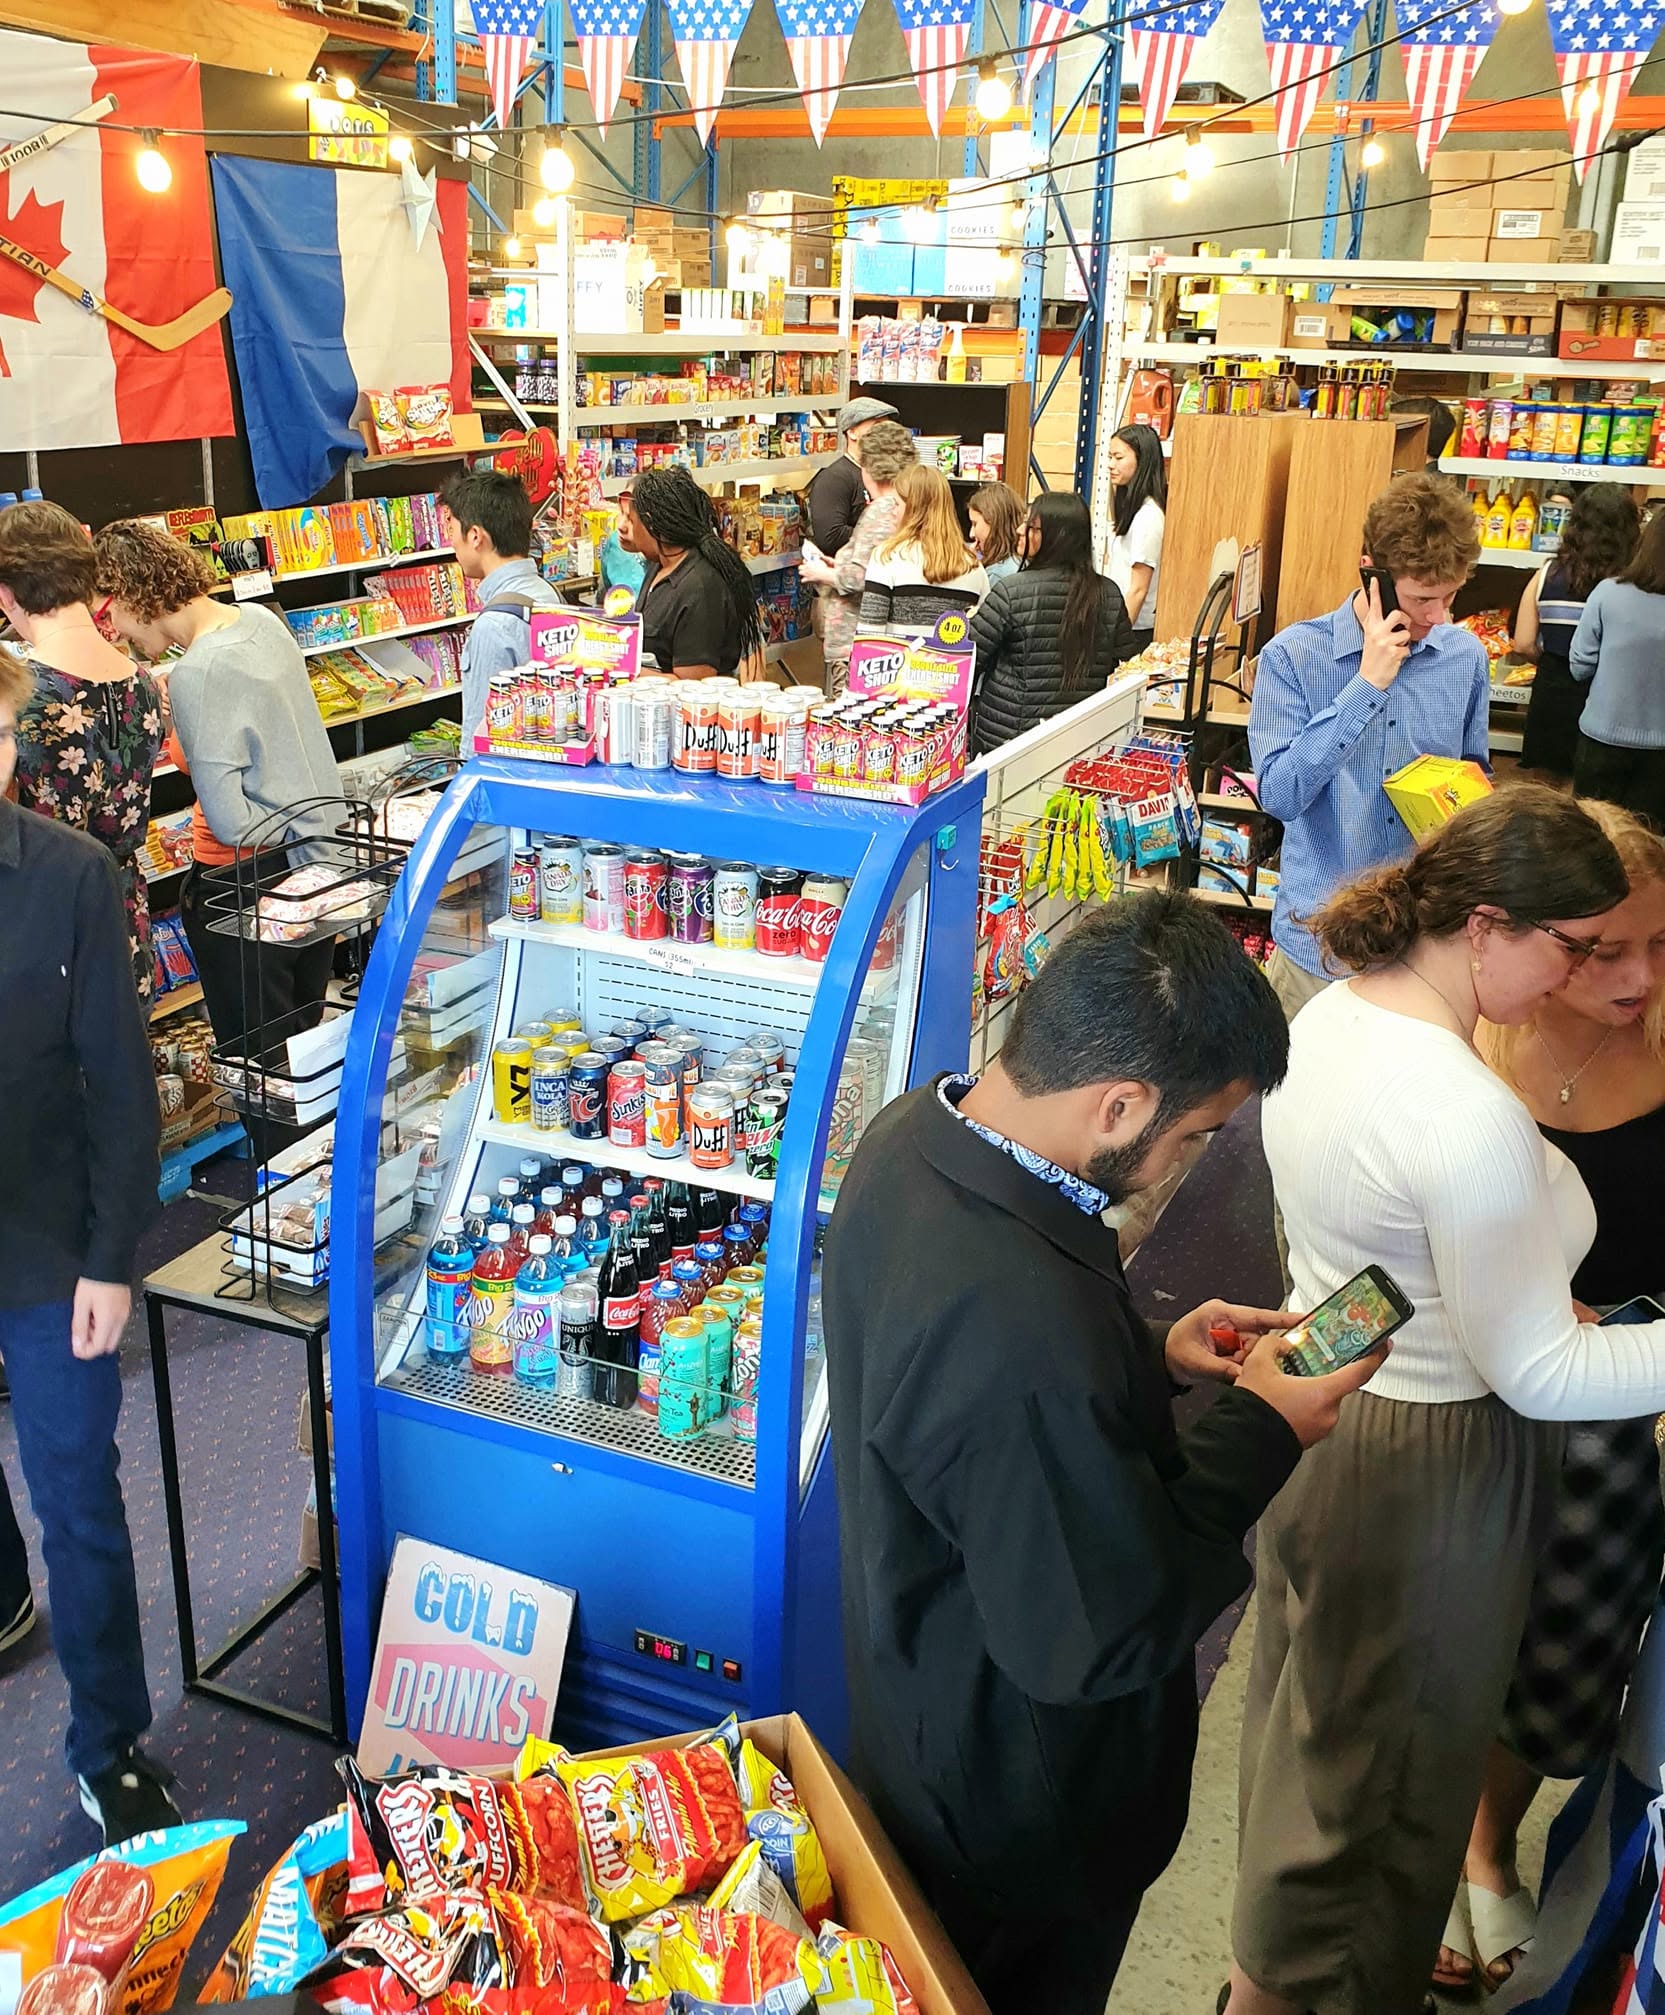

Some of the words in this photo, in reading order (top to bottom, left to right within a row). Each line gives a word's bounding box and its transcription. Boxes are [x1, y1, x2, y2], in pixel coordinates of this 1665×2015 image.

[577, 281, 603, 293] FFY
[1561, 465, 1600, 478] Snacks
[944, 622, 950, 632] 4
[537, 624, 579, 648] KETO
[544, 643, 575, 658] SHOT
[857, 652, 905, 678] KETO
[864, 671, 899, 688] SHOT
[1491, 688, 1527, 700] heetos
[489, 704, 515, 721] KETO
[685, 721, 718, 751] Duff
[719, 728, 750, 757] Duff
[762, 732, 777, 761] uff
[816, 741, 834, 754] KE
[833, 741, 859, 757] KETO
[867, 743, 894, 759] KETO
[900, 748, 927, 766] KETO
[511, 874, 531, 886] ETO
[772, 931, 796, 939] zero
[534, 1081, 566, 1093] INCA
[536, 1091, 563, 1101] KOLA
[611, 1092, 646, 1121] Sunkis
[693, 1121, 726, 1152] Duff
[639, 1353, 660, 1370] Clam
[671, 1408, 684, 1417] Tea
[413, 1560, 538, 1656] COLD
[384, 1656, 537, 1748] DRINKS
[649, 1789, 671, 1841] FRIES
[576, 1774, 634, 1886] CHESTER'S
